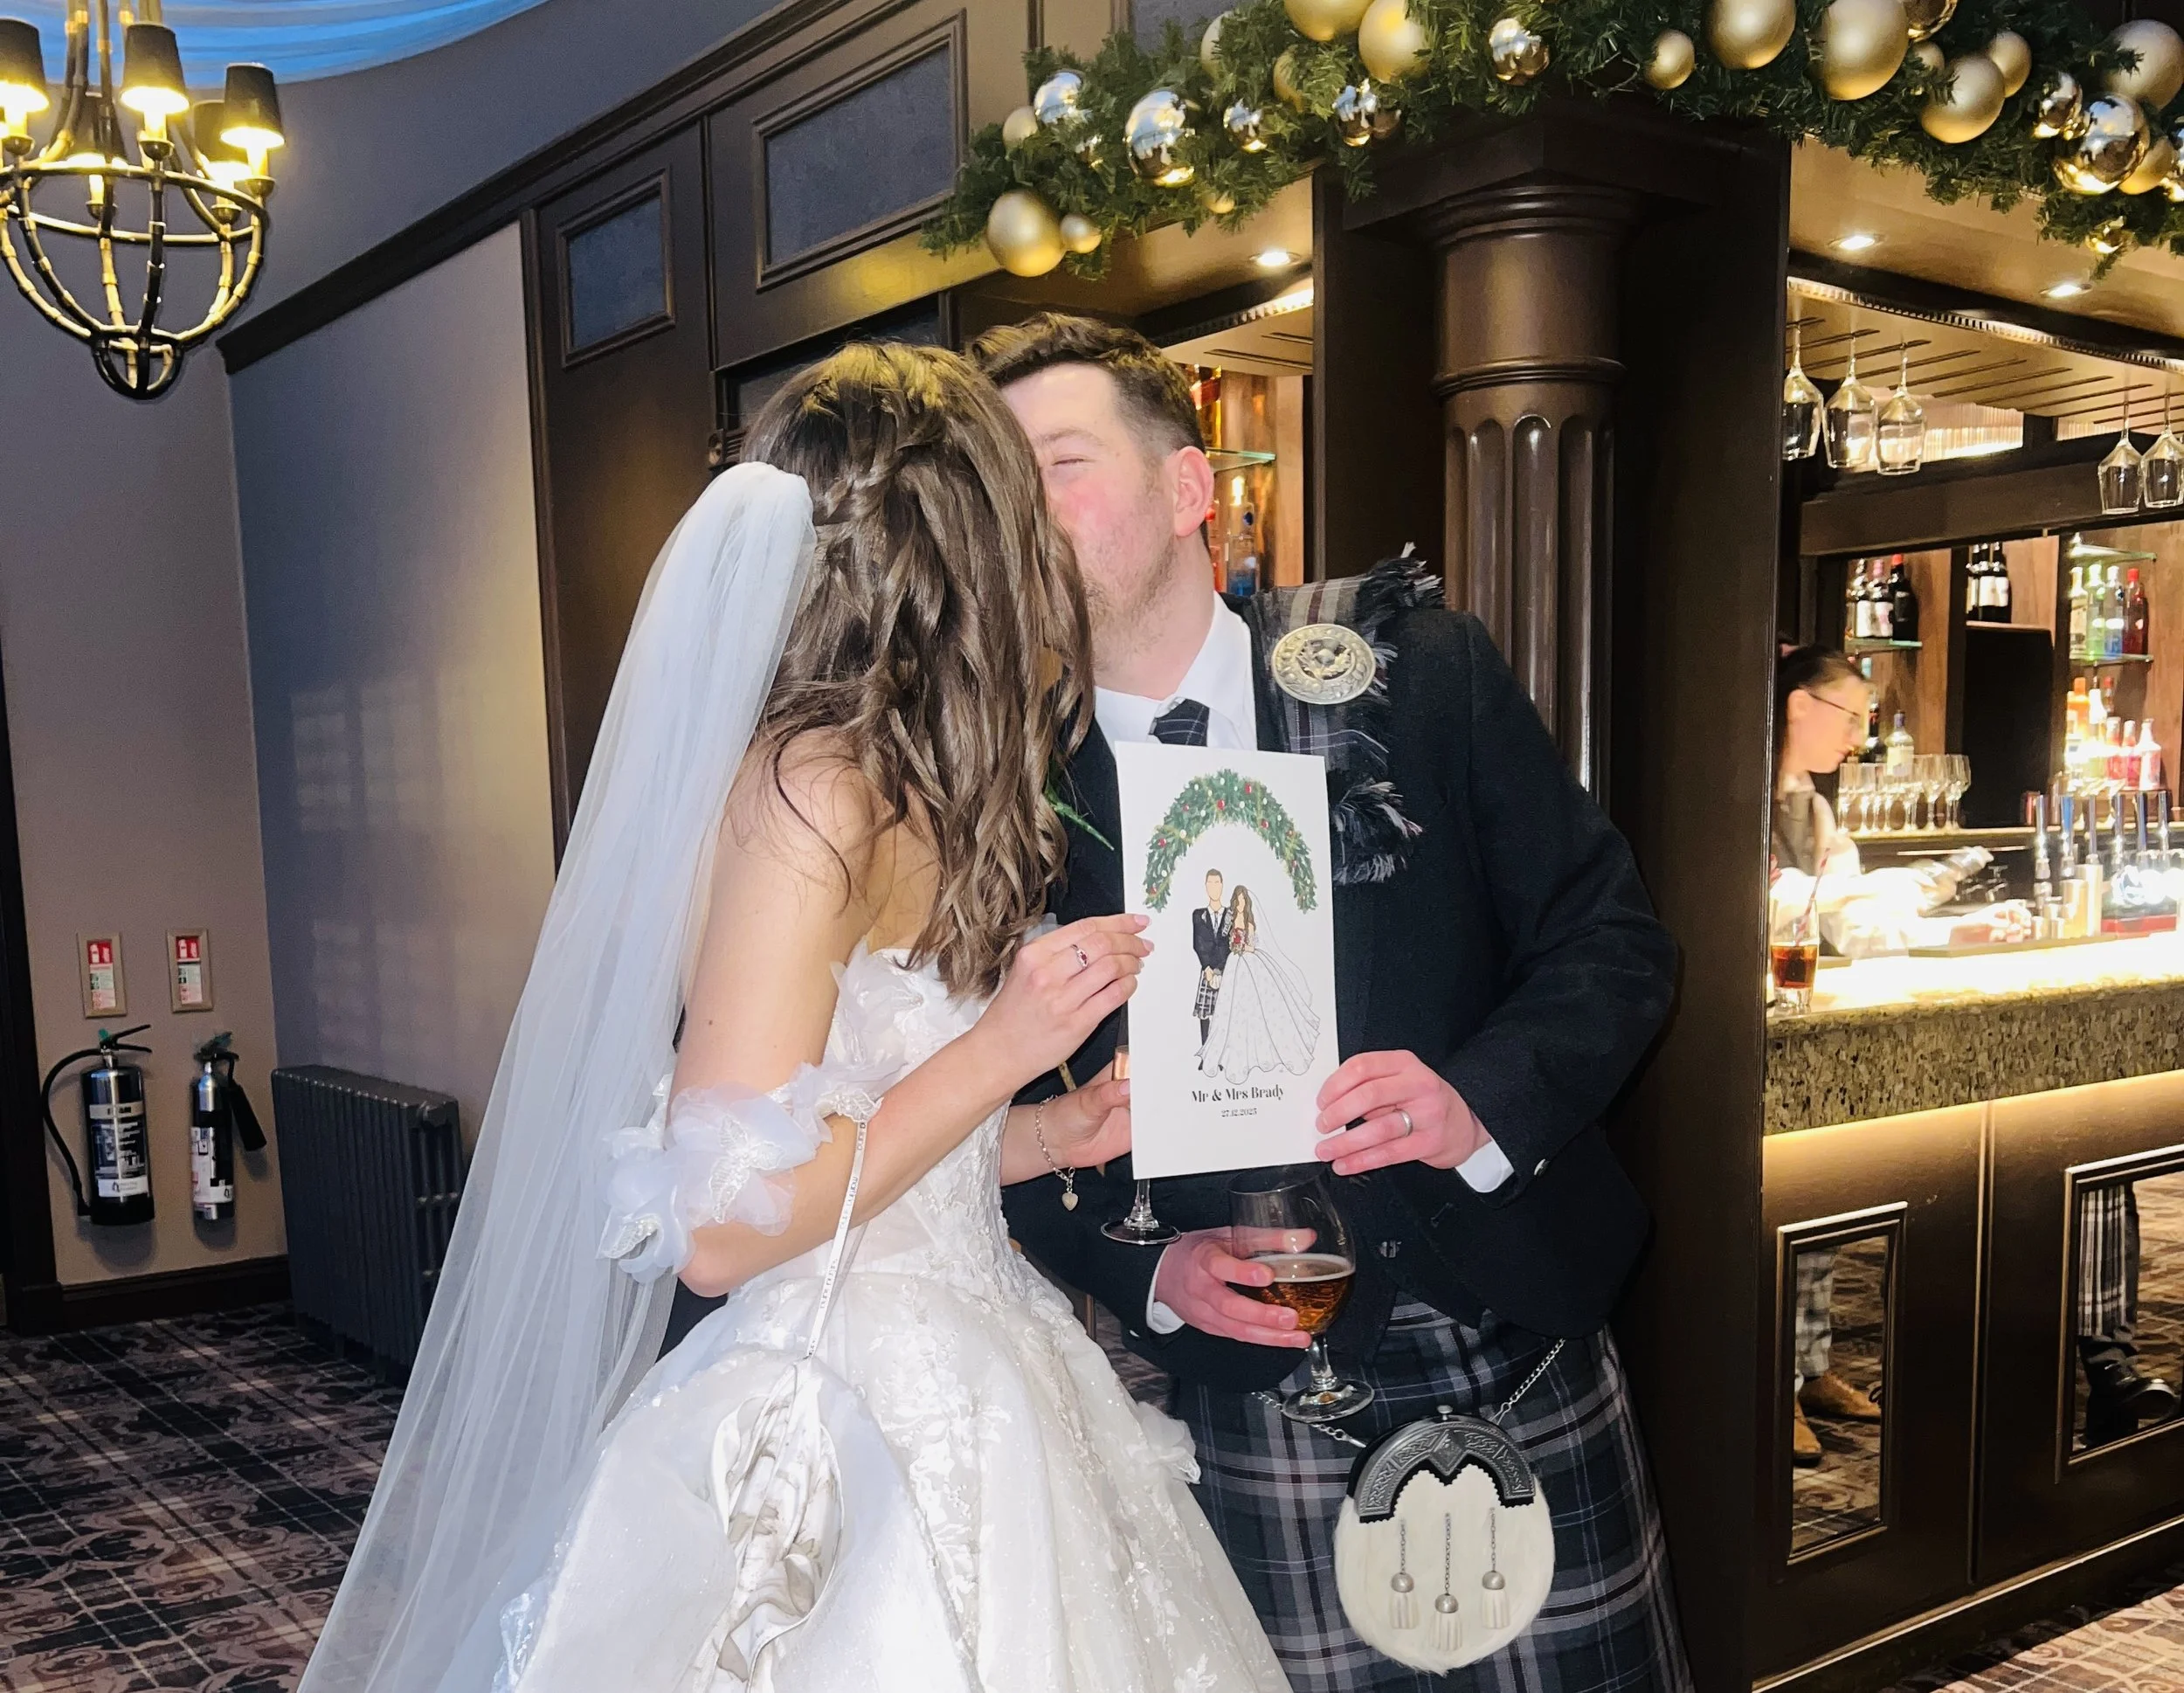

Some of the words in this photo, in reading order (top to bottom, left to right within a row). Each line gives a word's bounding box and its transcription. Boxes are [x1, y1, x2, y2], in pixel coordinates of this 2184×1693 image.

[1192, 1090, 1209, 1102] Mr
[1212, 1088, 1221, 1102] &
[1226, 1088, 1248, 1101] Mrs
[1251, 1084, 1284, 1101] Brady
